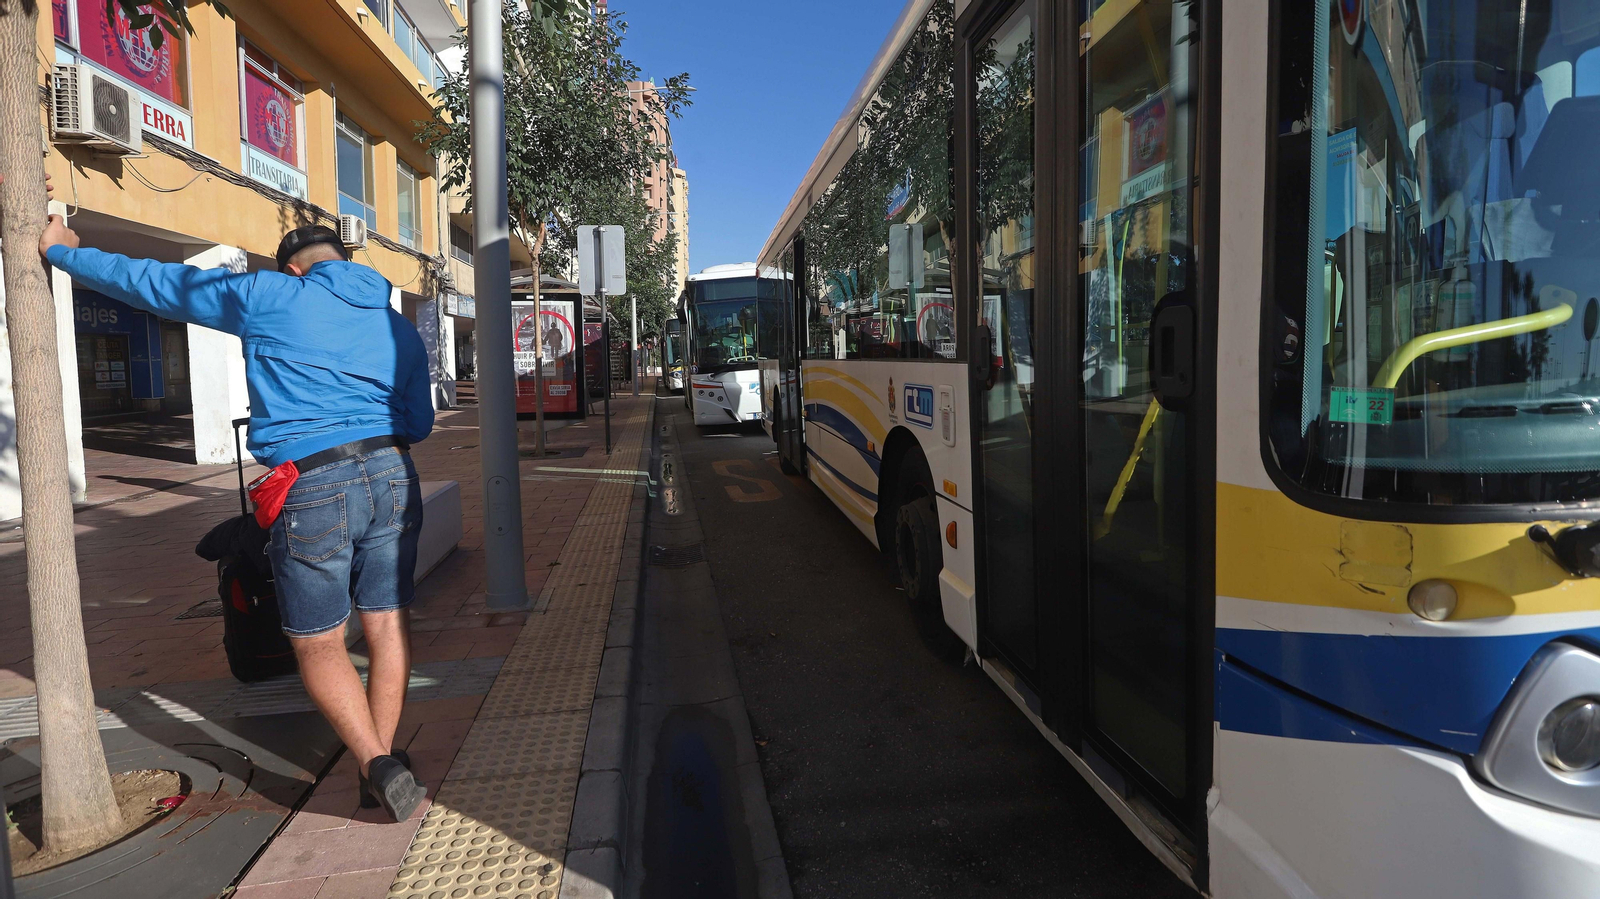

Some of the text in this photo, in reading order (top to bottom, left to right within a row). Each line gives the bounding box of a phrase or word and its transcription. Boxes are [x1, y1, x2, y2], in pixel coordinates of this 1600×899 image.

[141, 102, 186, 142] ERRA
[250, 156, 300, 194] TRANSITARIA
[75, 300, 118, 328] iajes
[1345, 396, 1358, 404] itv
[1369, 400, 1385, 410] 22
